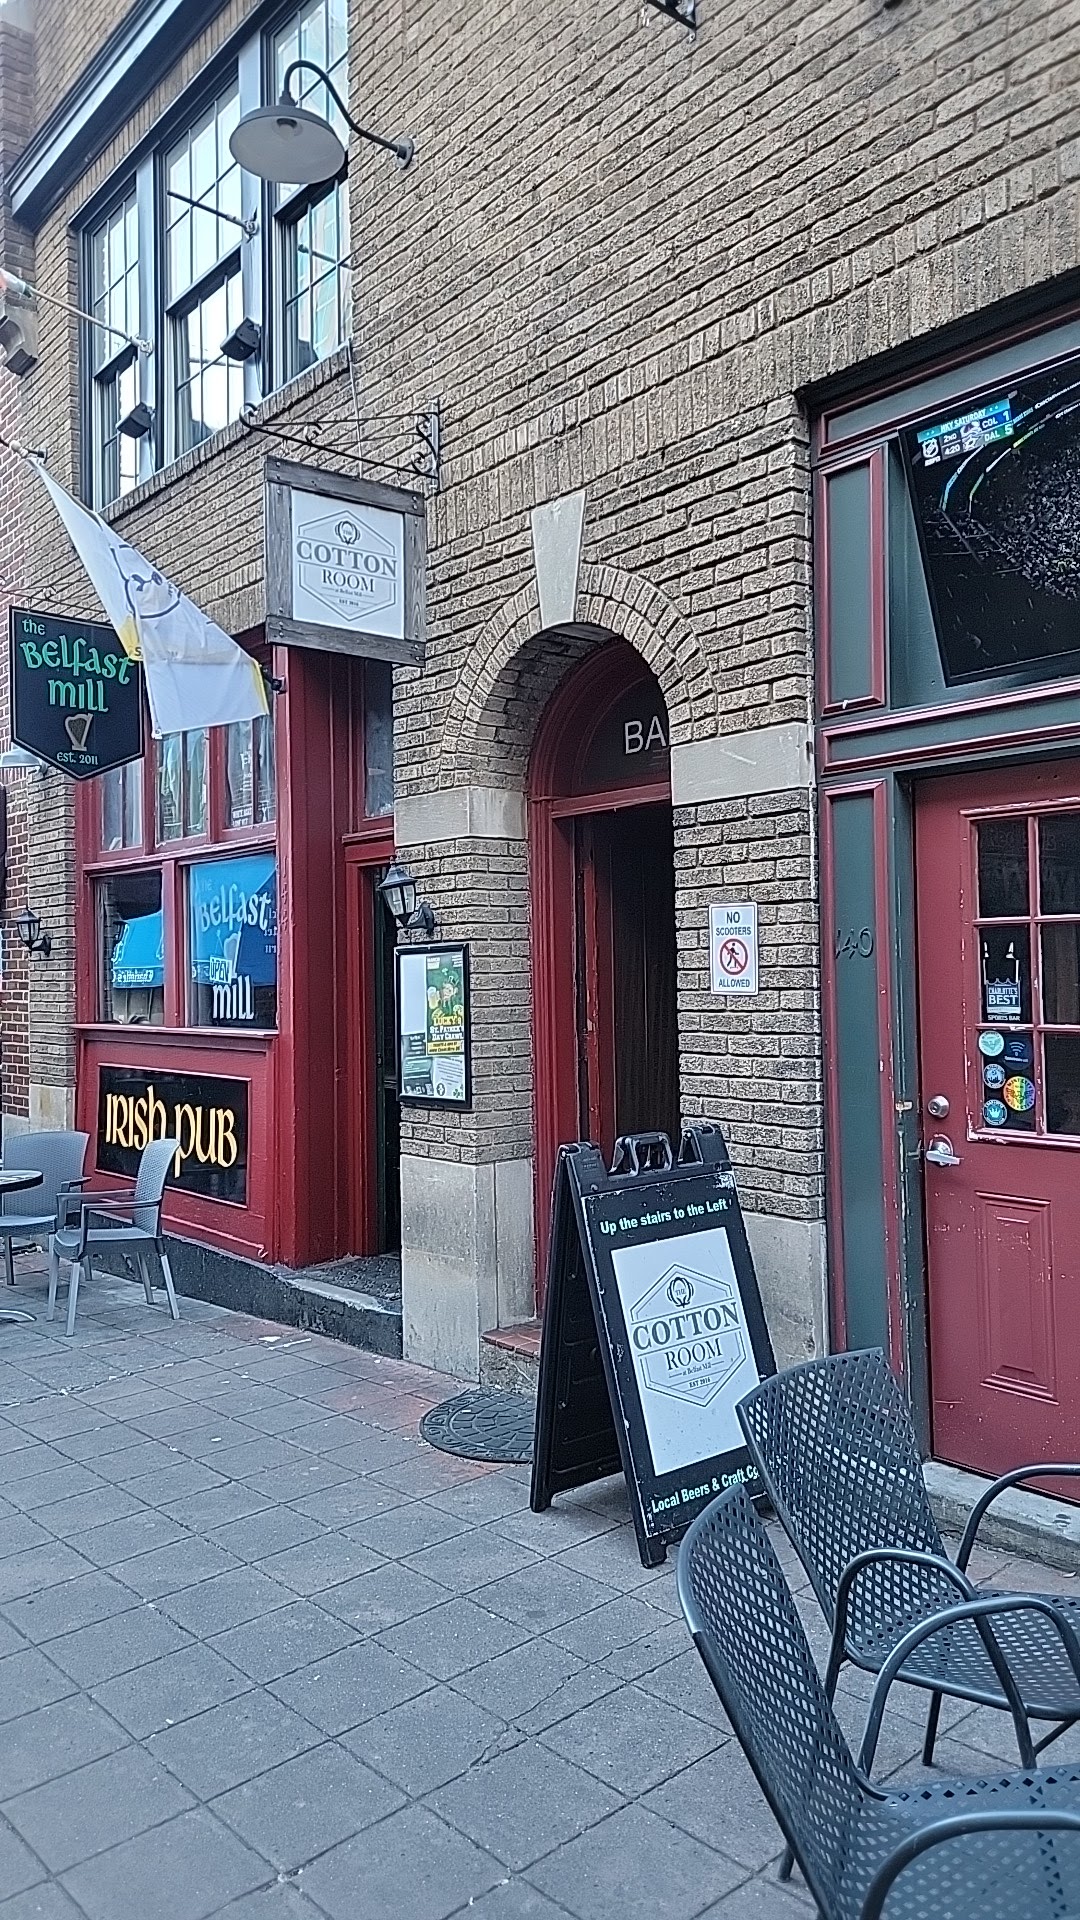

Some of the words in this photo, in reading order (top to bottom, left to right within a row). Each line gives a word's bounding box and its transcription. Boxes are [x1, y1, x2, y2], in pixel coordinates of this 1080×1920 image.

[954, 408, 986, 427] SATURDAY
[982, 418, 998, 429] COL
[1003, 411, 1010, 421] 1
[985, 430, 1001, 442] DAL
[1004, 423, 1013, 435] 5
[297, 540, 397, 578] COTTON
[322, 569, 375, 593] ROOM
[22, 618, 46, 635] the
[20, 635, 135, 685] Belfast
[624, 716, 667, 755] BA
[79, 754, 98, 765] 2011
[200, 883, 271, 933] Belfast
[726, 911, 741, 924] NO
[715, 926, 752, 937] SCOOTERS
[834, 926, 874, 960] 140
[211, 958, 229, 982] OPEN
[718, 978, 751, 988] ALLOWED
[988, 995, 1018, 1005] BEST
[600, 1221, 617, 1235] Up
[619, 1217, 638, 1231] the
[640, 1210, 671, 1226] stairs
[673, 1207, 685, 1219] to
[686, 1203, 704, 1217] the
[706, 1198, 728, 1213] Left
[632, 1301, 740, 1350] COTTON
[665, 1338, 723, 1371] ROOM
[689, 1379, 699, 1388] EST
[651, 1491, 680, 1513] Local
[681, 1484, 710, 1502] Beers
[711, 1477, 720, 1491] &
[721, 1467, 746, 1487] Craft
